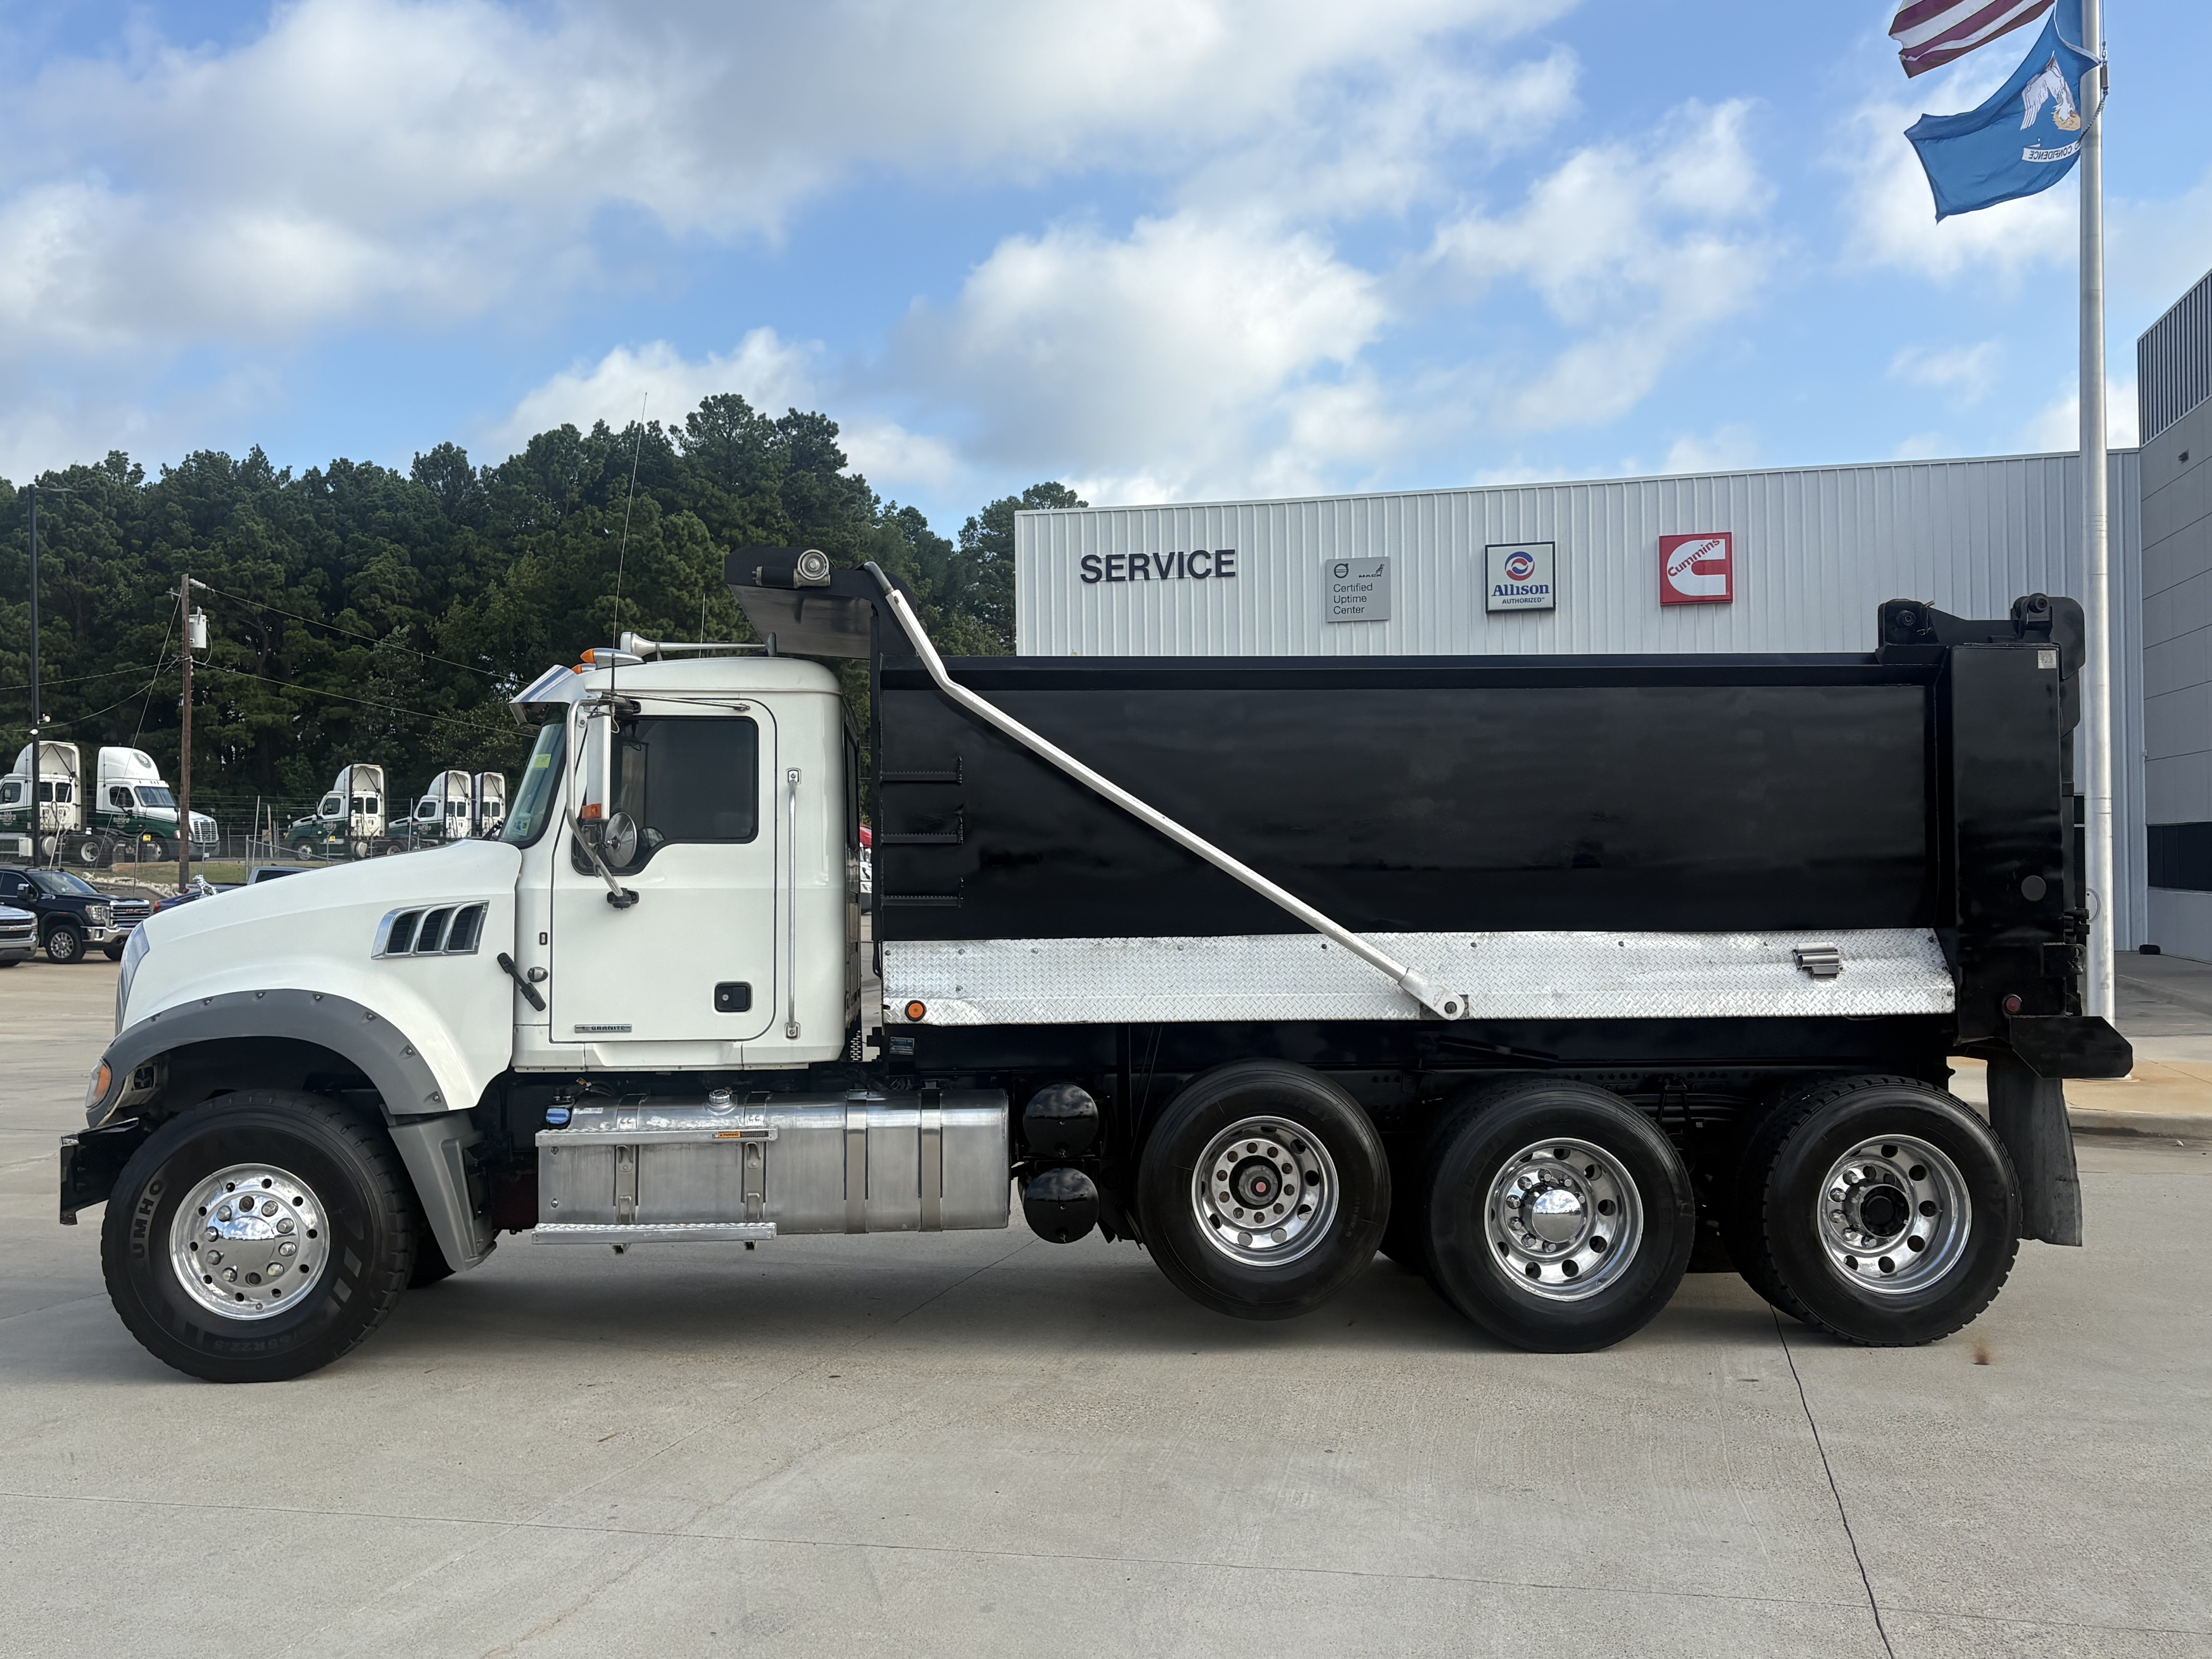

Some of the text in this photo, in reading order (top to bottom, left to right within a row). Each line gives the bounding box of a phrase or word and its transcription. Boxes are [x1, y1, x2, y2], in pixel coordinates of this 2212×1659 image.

[1668, 539, 1720, 577] Cummins
[1080, 549, 1236, 583] SERVICE
[1333, 583, 1372, 592] Certified
[1491, 584, 1550, 596] Allison
[1334, 594, 1367, 605] Uptime
[1333, 606, 1365, 615] Center
